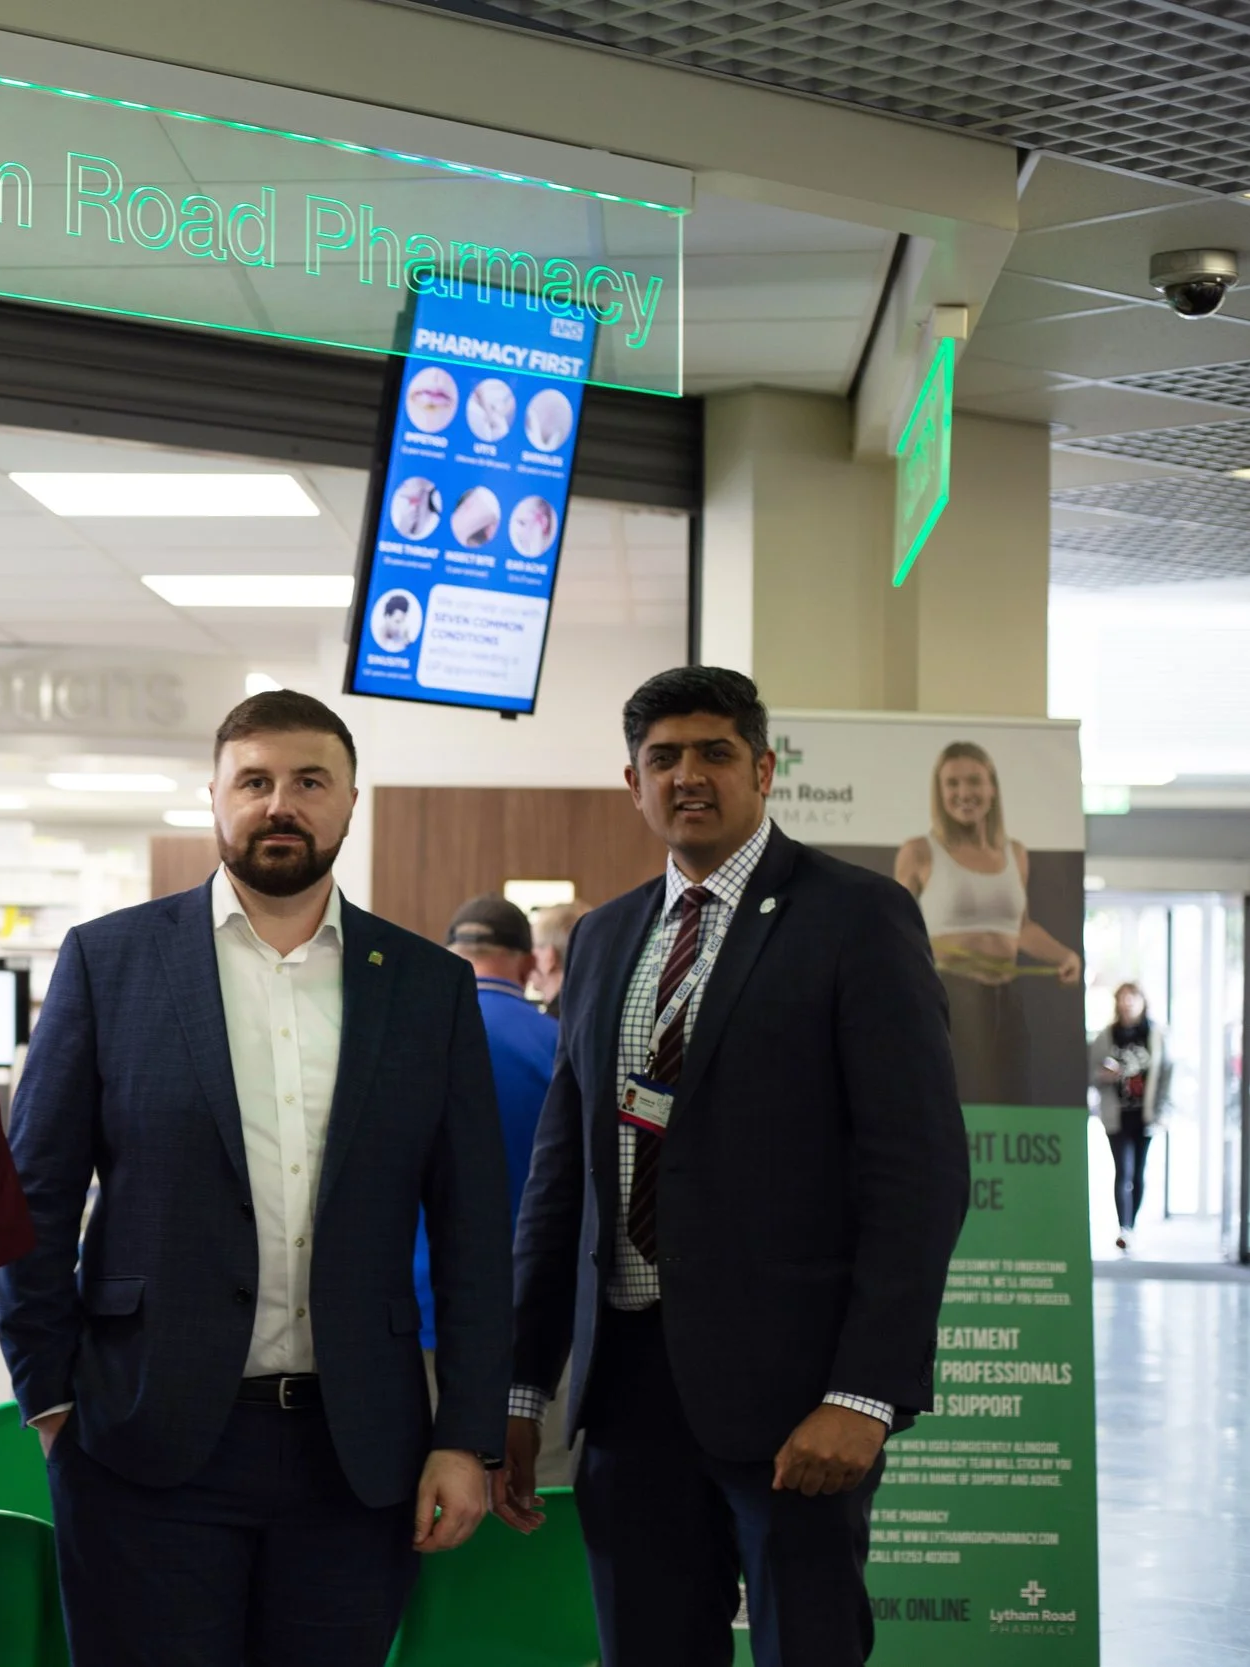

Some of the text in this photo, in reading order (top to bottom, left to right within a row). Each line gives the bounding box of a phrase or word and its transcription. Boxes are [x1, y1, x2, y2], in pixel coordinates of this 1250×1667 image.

[66, 151, 276, 268] Road
[304, 194, 664, 350] Pharmacy
[415, 328, 584, 378] PHARMACY FIRST
[798, 783, 853, 802] Road
[1004, 1133, 1062, 1165] LOSS
[937, 1326, 1020, 1350] REATMENT
[941, 1360, 1072, 1384] PROFESSIONALS
[948, 1395, 1022, 1417] SUPPORT
[870, 1597, 970, 1622] OOK ONLINE
[990, 1609, 1076, 1623] Lytham Road
[990, 1624, 1076, 1636] PHARMACY
